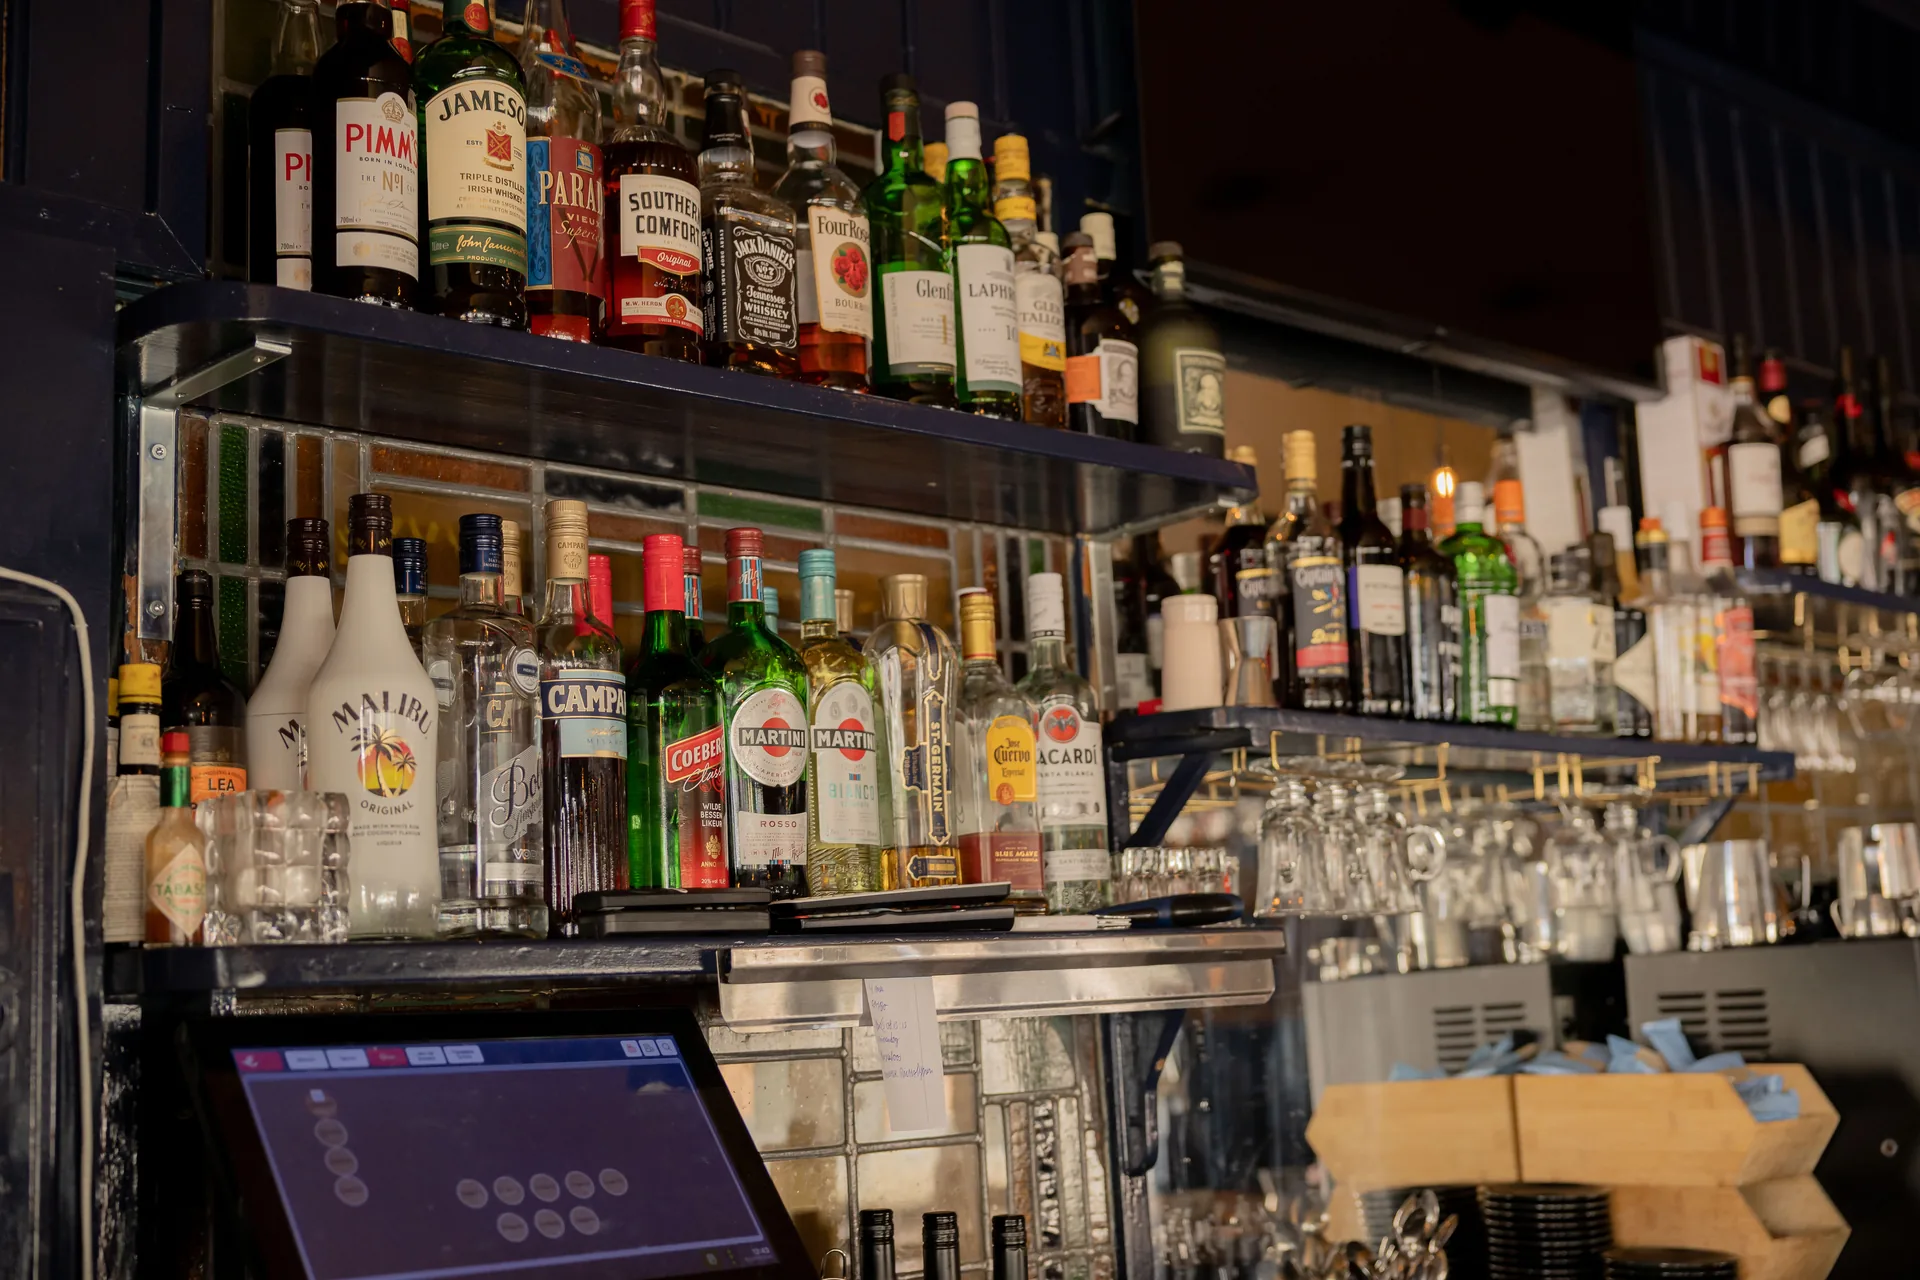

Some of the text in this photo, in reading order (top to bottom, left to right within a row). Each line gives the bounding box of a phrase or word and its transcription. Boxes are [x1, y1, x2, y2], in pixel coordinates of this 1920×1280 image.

[439, 90, 525, 128] JAMESO
[361, 174, 376, 182] THE
[460, 172, 492, 183] TRIPLE
[468, 185, 492, 194] IRISH
[635, 214, 700, 248] COMFORT
[817, 216, 849, 236] Four
[456, 234, 482, 253] John
[656, 252, 692, 268] Original
[733, 235, 796, 271] JACK DANIEL'S
[746, 284, 786, 305] Tennessee
[743, 301, 789, 320] WHISKEY
[332, 691, 433, 734] MALIBU
[741, 729, 804, 747] MARTINI
[993, 744, 1031, 765] Cuervo
[930, 721, 944, 812] ST-GERMAIN
[208, 778, 235, 791] LEA
[828, 782, 875, 800] BIANCO
[360, 799, 414, 815] ORIGINAL
[700, 811, 722, 820] BESSEN
[702, 803, 722, 811] WILDE
[701, 820, 723, 828] LIKEUR
[760, 820, 797, 828] ROSSO
